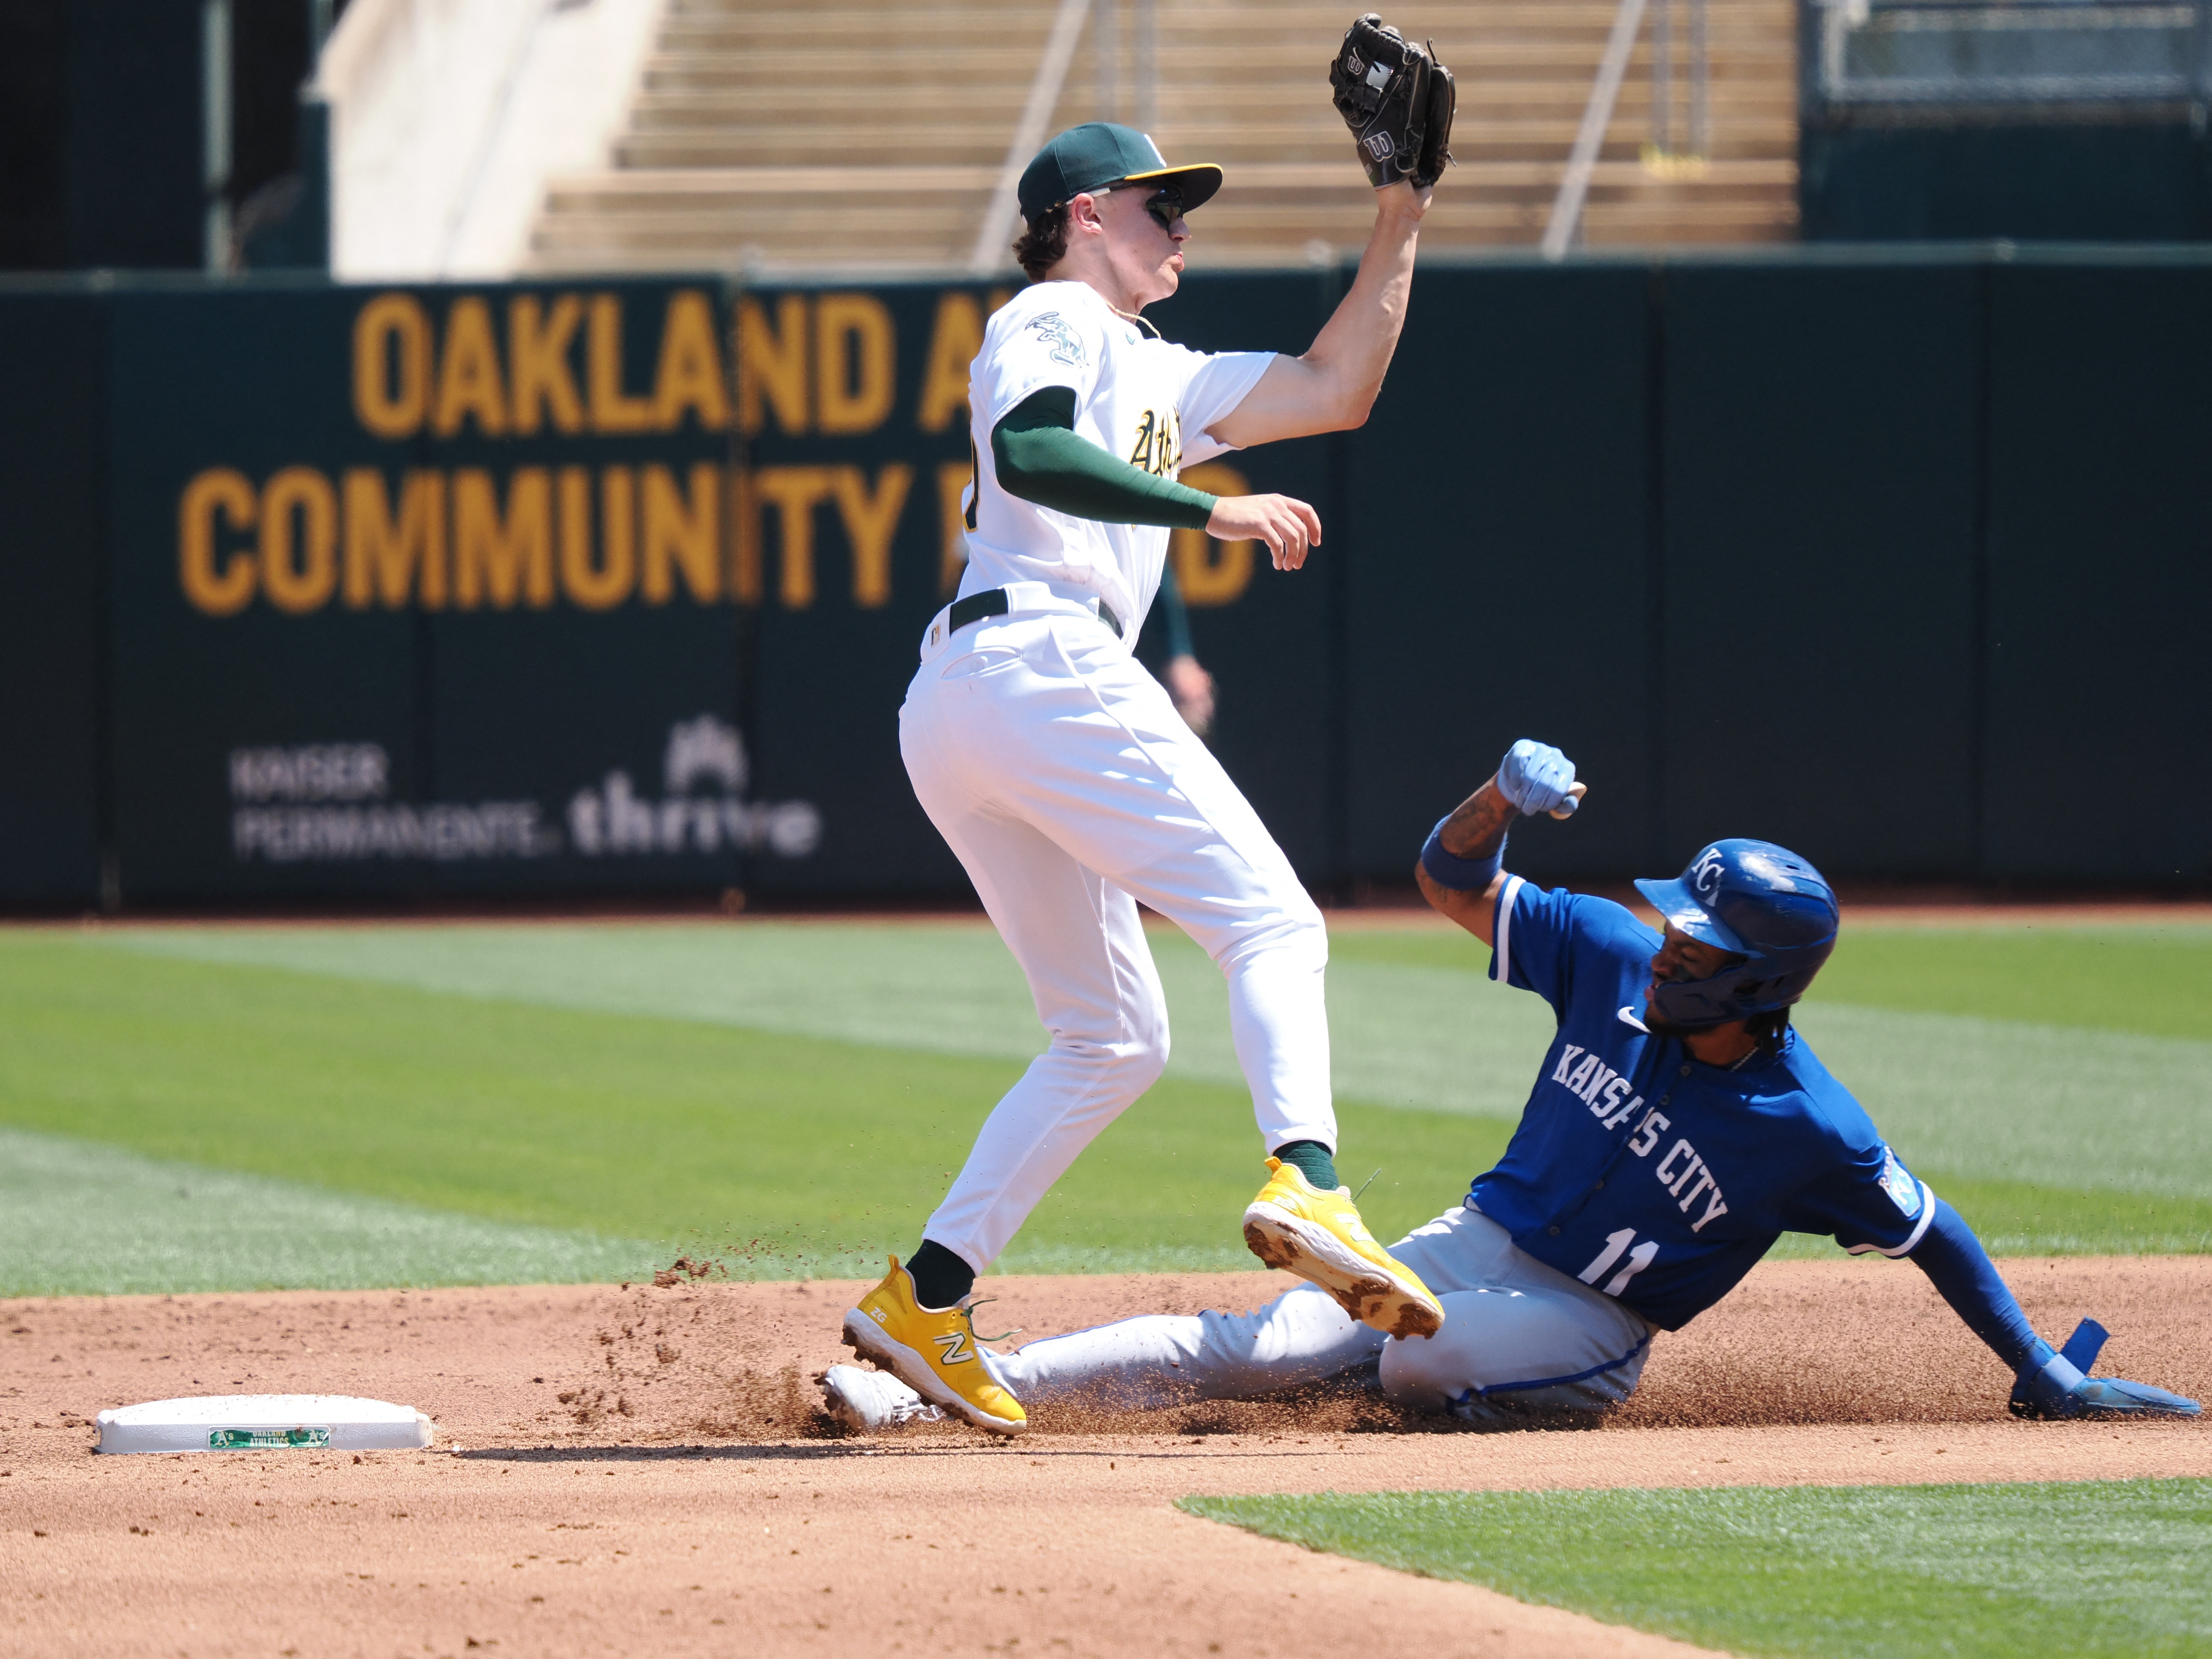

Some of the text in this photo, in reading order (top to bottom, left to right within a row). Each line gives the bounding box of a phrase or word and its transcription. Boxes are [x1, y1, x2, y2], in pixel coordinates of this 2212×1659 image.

[1363, 130, 1395, 162] W
[352, 293, 896, 438] OAKLAND
[178, 463, 913, 615] COMMUNITY
[228, 743, 388, 800] KAISER
[568, 768, 822, 858] thrive
[1691, 848, 1725, 891] KC
[1551, 1044, 1729, 1233] KANSAS CITY
[1577, 1227, 1660, 1297] 11
[870, 1306, 888, 1324] ZG
[214, 1431, 234, 1447] A's
[250, 1438, 289, 1447] ATHLETICS
